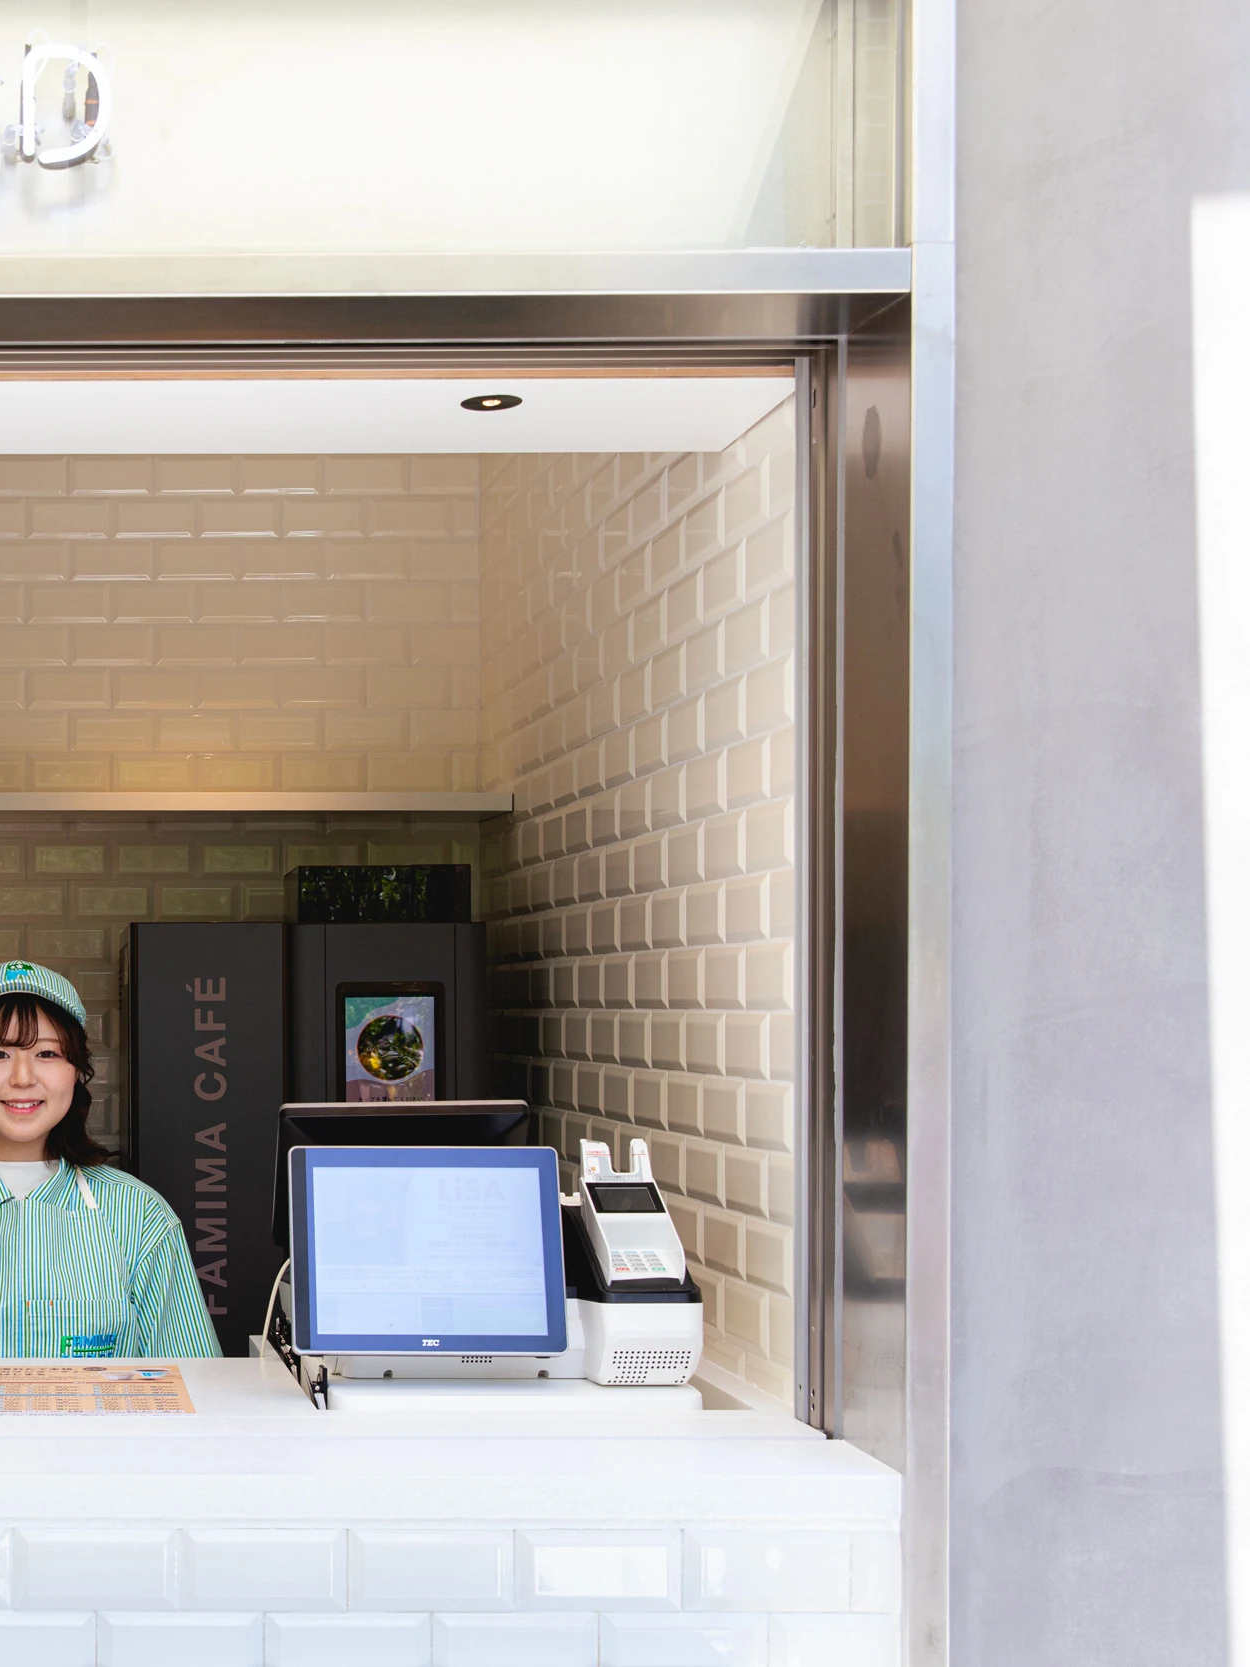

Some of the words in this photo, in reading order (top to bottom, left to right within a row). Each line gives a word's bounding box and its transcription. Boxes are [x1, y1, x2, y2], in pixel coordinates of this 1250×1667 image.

[186, 977, 227, 1101] CAFÉ
[194, 1123, 228, 1315] FAMIMA
[61, 1333, 117, 1353] FAMIMA
[421, 1339, 440, 1347] TEC
